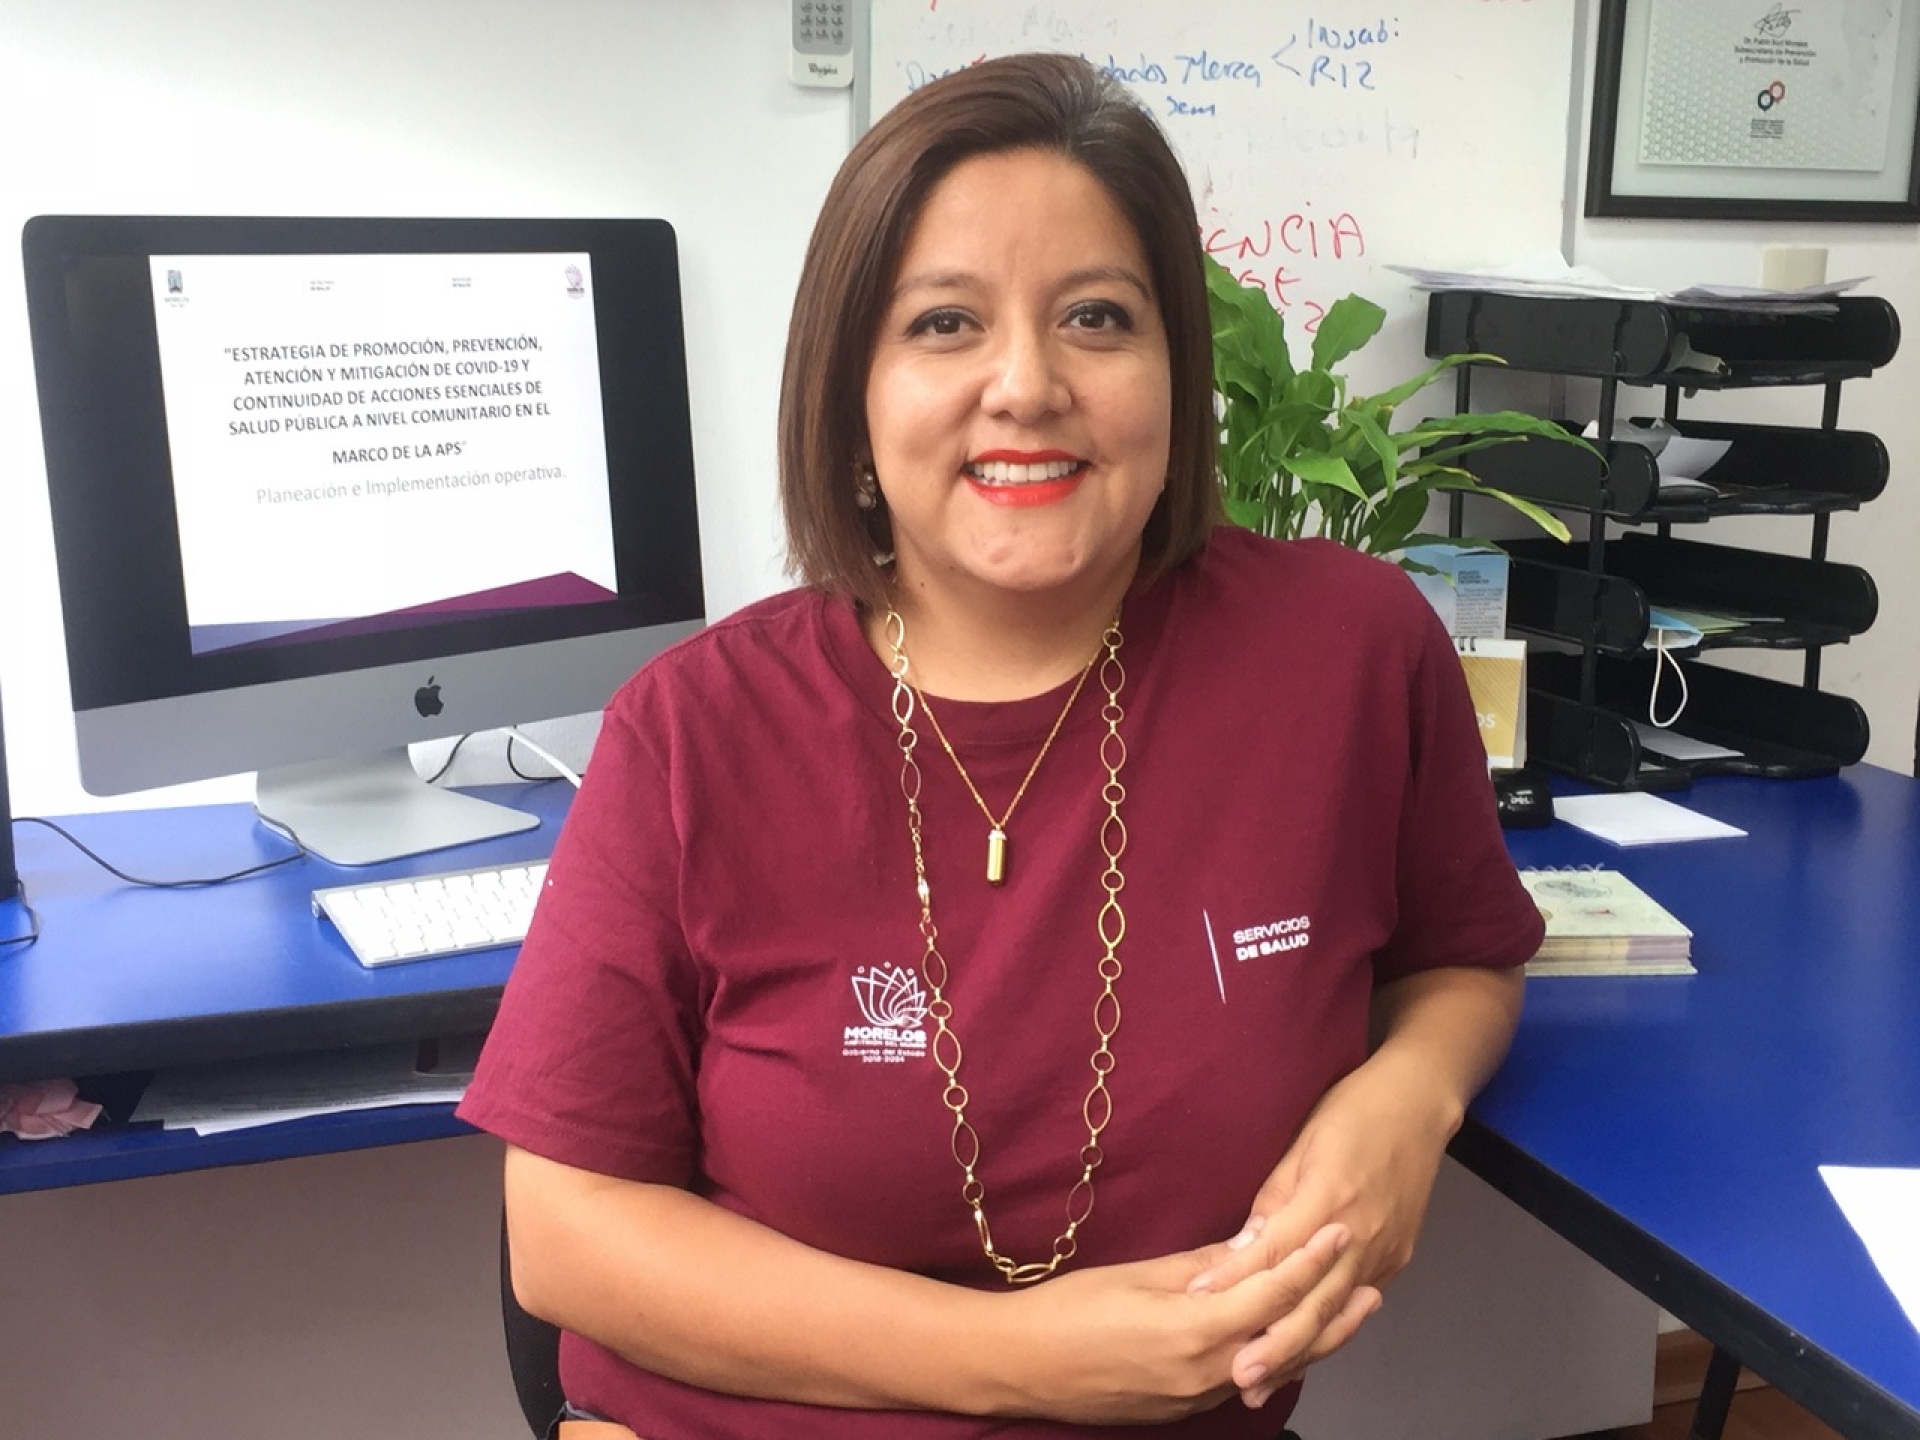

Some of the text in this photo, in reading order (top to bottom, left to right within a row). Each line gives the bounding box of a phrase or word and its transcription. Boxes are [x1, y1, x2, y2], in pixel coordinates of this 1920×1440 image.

[329, 343, 349, 358] DE
[353, 337, 450, 356] PROMOCIÓN,
[452, 333, 543, 353] PREVENCIÓN,
[244, 358, 530, 386] ATENCIÓN Y MITIGACIÓN DE COVID-19 Y
[233, 380, 543, 411] CONTINUIDAD DE ACCIONES ESENCIALES DE
[229, 402, 551, 435] SALUD PÚBLICA A NIVEL COMUNITARIO EN EL
[332, 447, 389, 464] MARCO
[392, 445, 411, 459] DE
[415, 444, 432, 458] LA
[257, 466, 566, 504] Planeación e Implementación operativa.
[1232, 914, 1311, 944] SERVICIOS
[1235, 932, 1310, 962] DE SALUD
[843, 1025, 928, 1042] MORELOS
